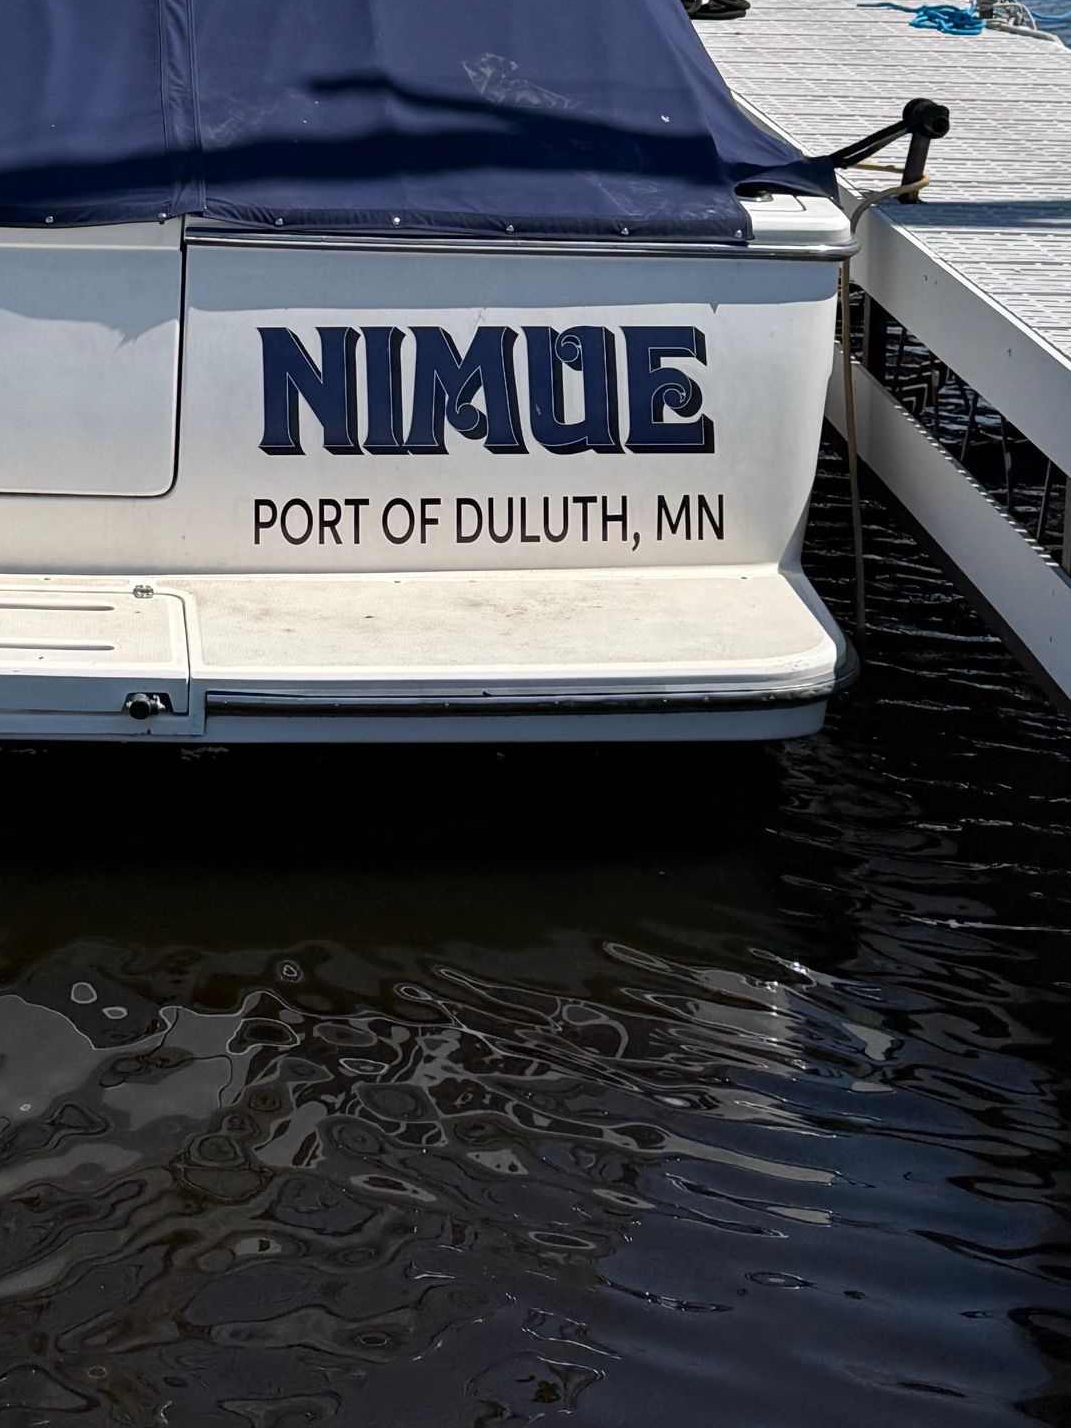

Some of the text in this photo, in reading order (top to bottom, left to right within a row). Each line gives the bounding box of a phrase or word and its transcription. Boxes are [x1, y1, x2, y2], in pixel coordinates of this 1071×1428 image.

[256, 325, 715, 456] NIMUE
[254, 494, 725, 552] PORT OF DULUTH, MN
